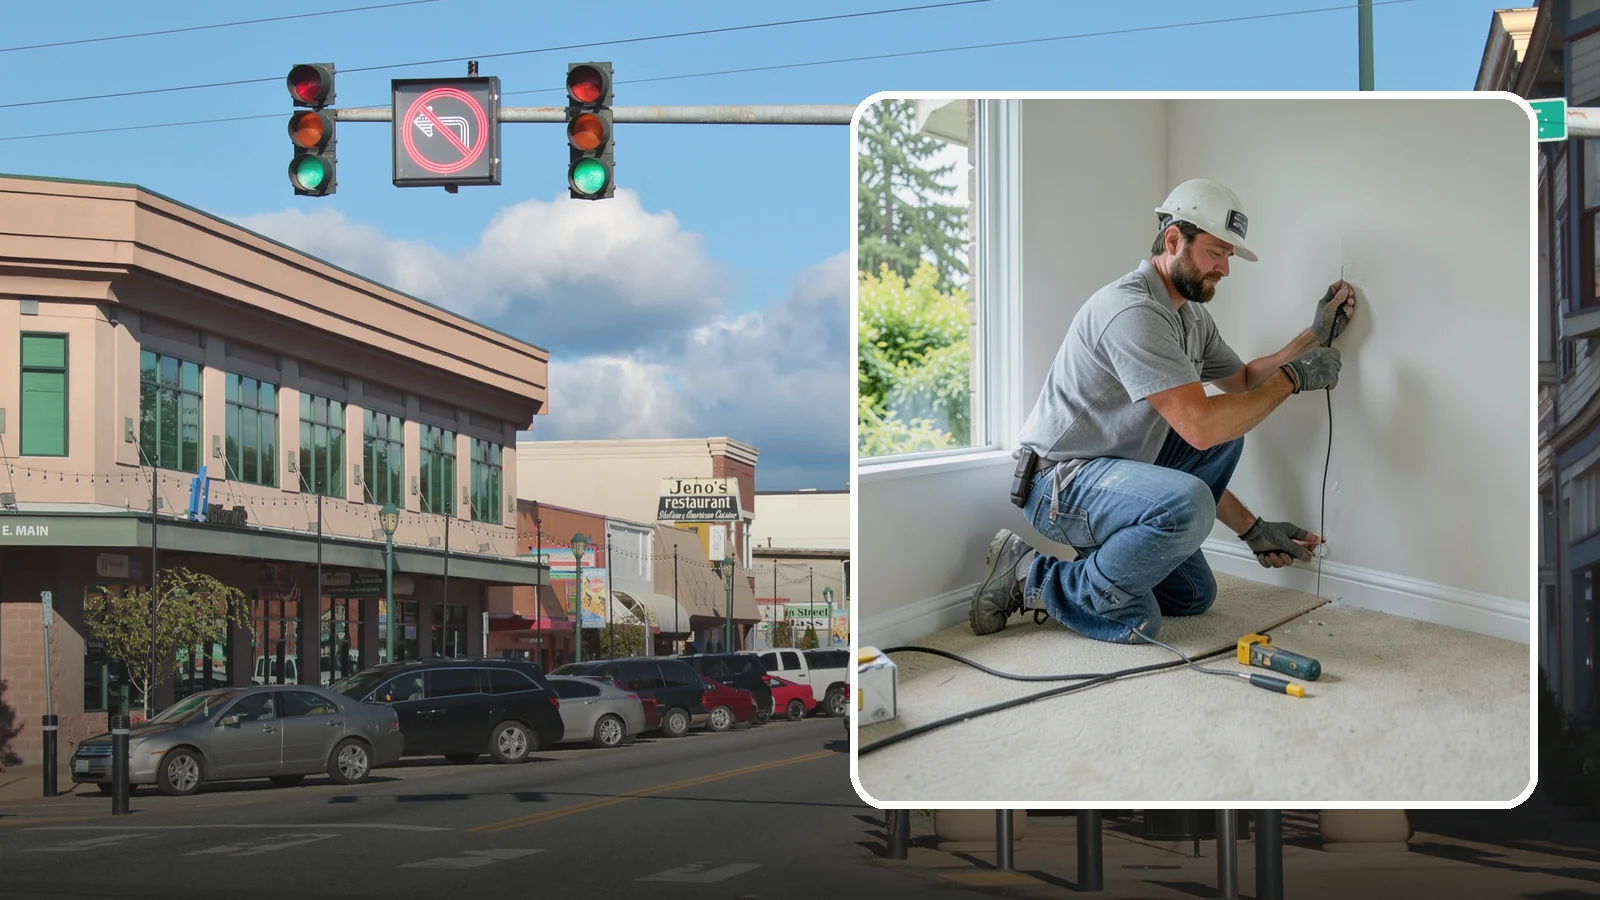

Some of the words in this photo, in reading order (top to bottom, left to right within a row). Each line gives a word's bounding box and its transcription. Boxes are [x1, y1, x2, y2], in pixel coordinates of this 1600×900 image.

[669, 480, 728, 495] Jeno's
[665, 496, 731, 509] restaurant
[658, 510, 681, 519] Italian
[686, 509, 714, 519] American
[715, 509, 737, 519] Cuisine
[2, 525, 13, 536] E.
[15, 525, 49, 536] MAIN
[797, 608, 829, 617] Street
